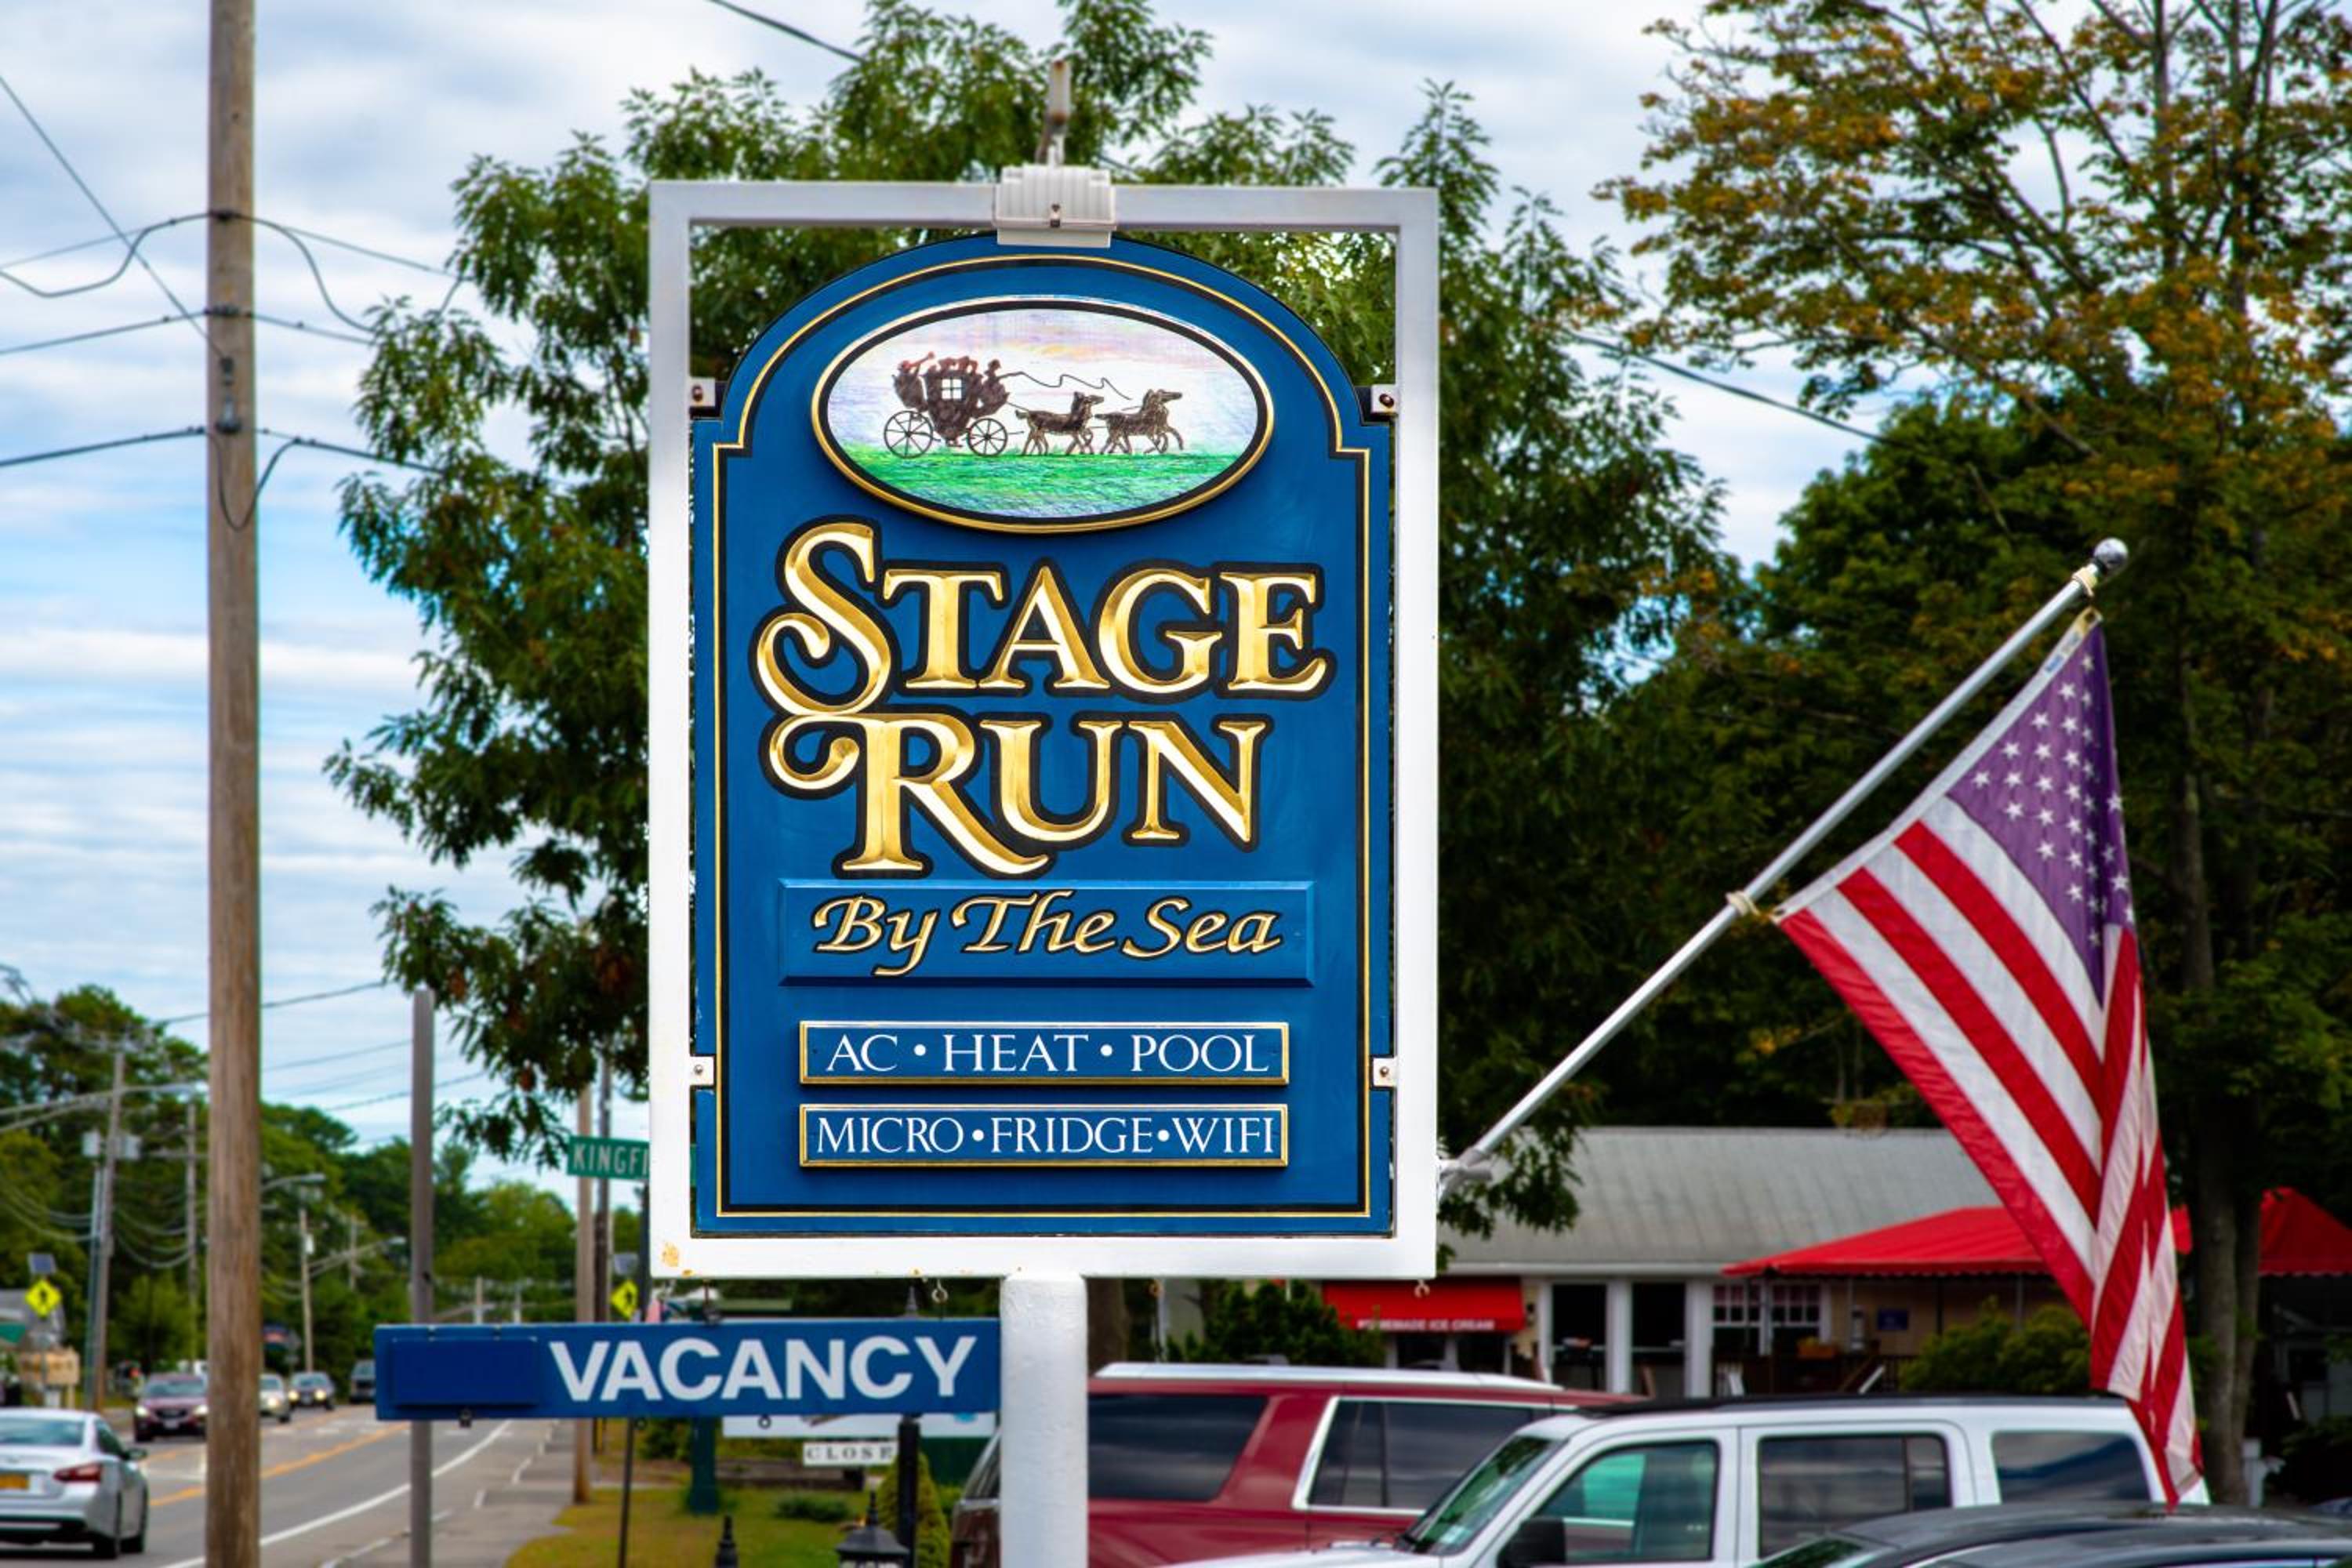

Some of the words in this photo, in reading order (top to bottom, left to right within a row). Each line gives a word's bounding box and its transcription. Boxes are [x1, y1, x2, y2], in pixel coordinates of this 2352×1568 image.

[755, 521, 1327, 716] STAGE
[768, 713, 1267, 875] RUN
[813, 892, 938, 977] By
[951, 890, 1116, 955] The
[1121, 896, 1283, 959] Sea
[826, 1033, 899, 1073] AC
[943, 1033, 1090, 1073] HEAT
[1130, 1033, 1270, 1073] POOL
[549, 1335, 978, 1402] VACANCY
